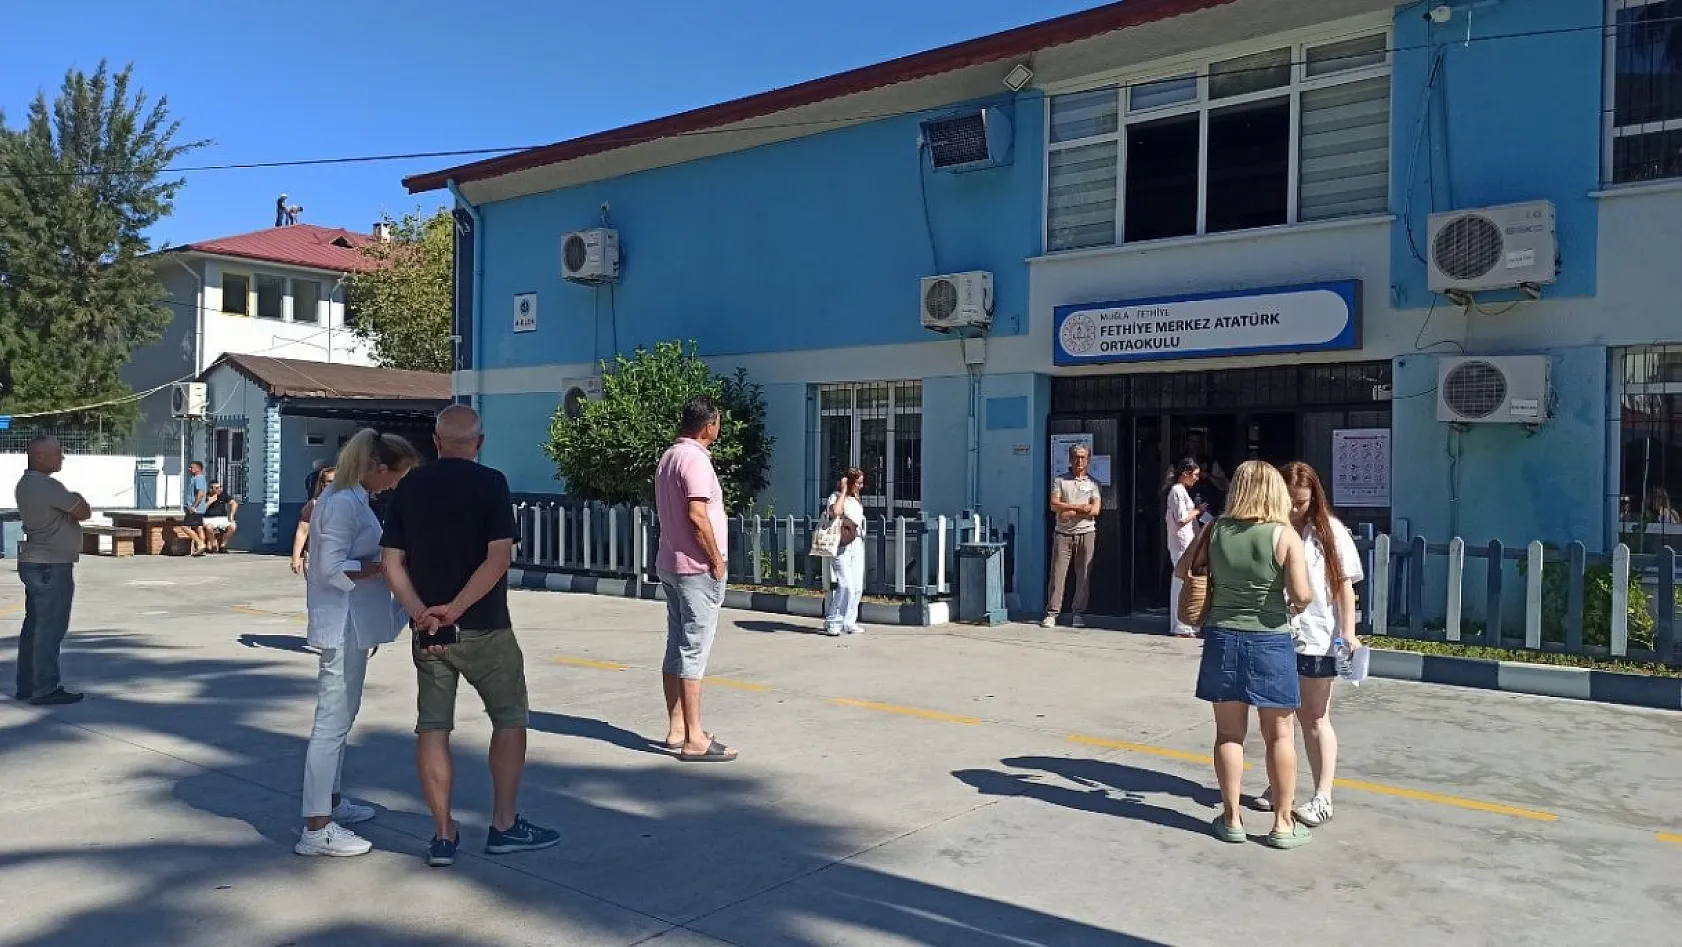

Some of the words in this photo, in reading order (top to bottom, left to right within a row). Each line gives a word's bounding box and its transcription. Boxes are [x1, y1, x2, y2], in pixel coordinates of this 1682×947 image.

[1138, 308, 1170, 318] FETHİYE
[1100, 322, 1152, 337] FETHİYE
[1155, 319, 1211, 333] MERKEZ
[1214, 312, 1280, 329] ATATÜRK
[1100, 336, 1180, 352] ORTAOKULU
